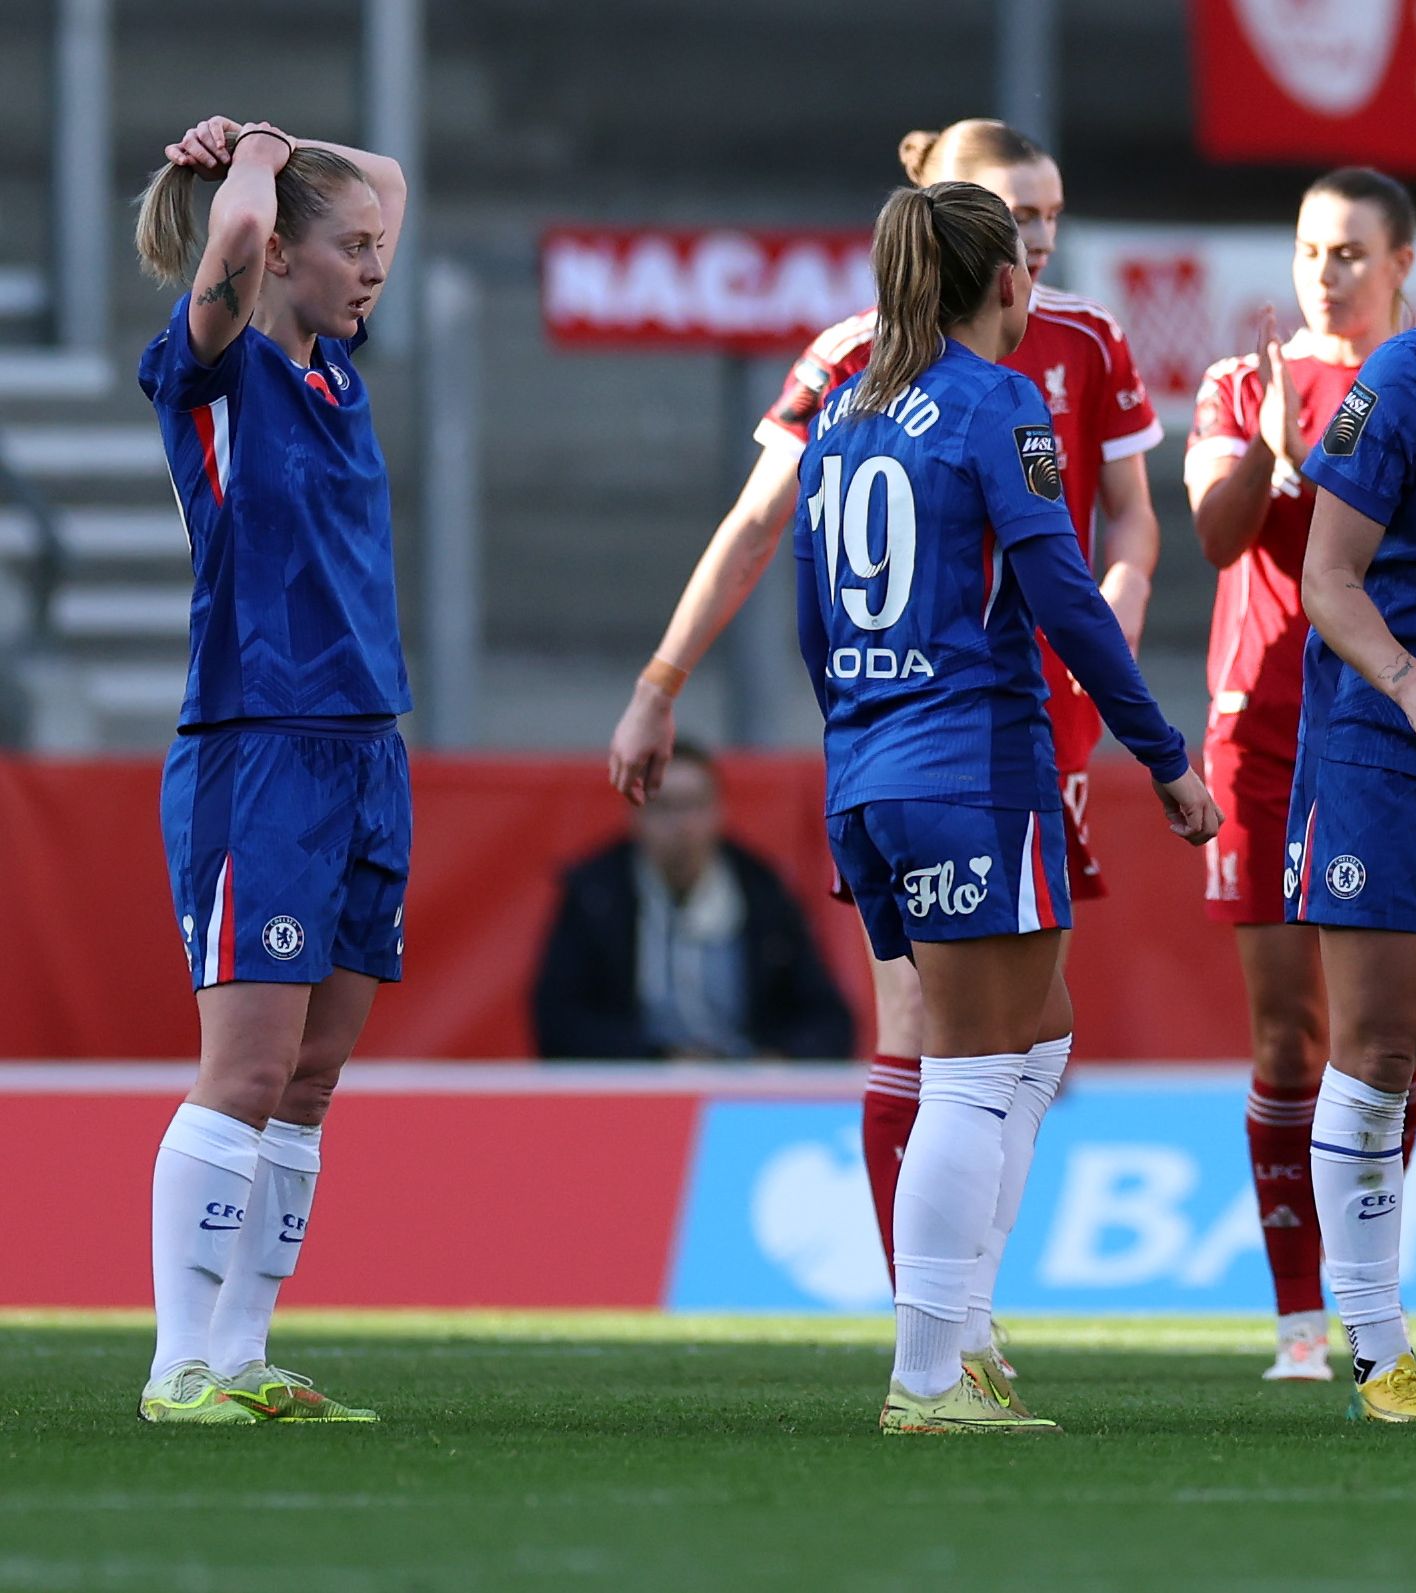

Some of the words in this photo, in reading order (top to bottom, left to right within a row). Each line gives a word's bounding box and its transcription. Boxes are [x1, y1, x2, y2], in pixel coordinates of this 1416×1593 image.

[817, 385, 940, 442] KARYD
[1021, 436, 1055, 452] WSL
[807, 455, 917, 631] 19
[825, 646, 935, 679] ODA
[902, 859, 988, 918] Flo
[1254, 1163, 1302, 1181] LFC
[205, 1201, 245, 1223] CFC
[1360, 1194, 1397, 1208] CFC
[282, 1213, 309, 1232] CF
